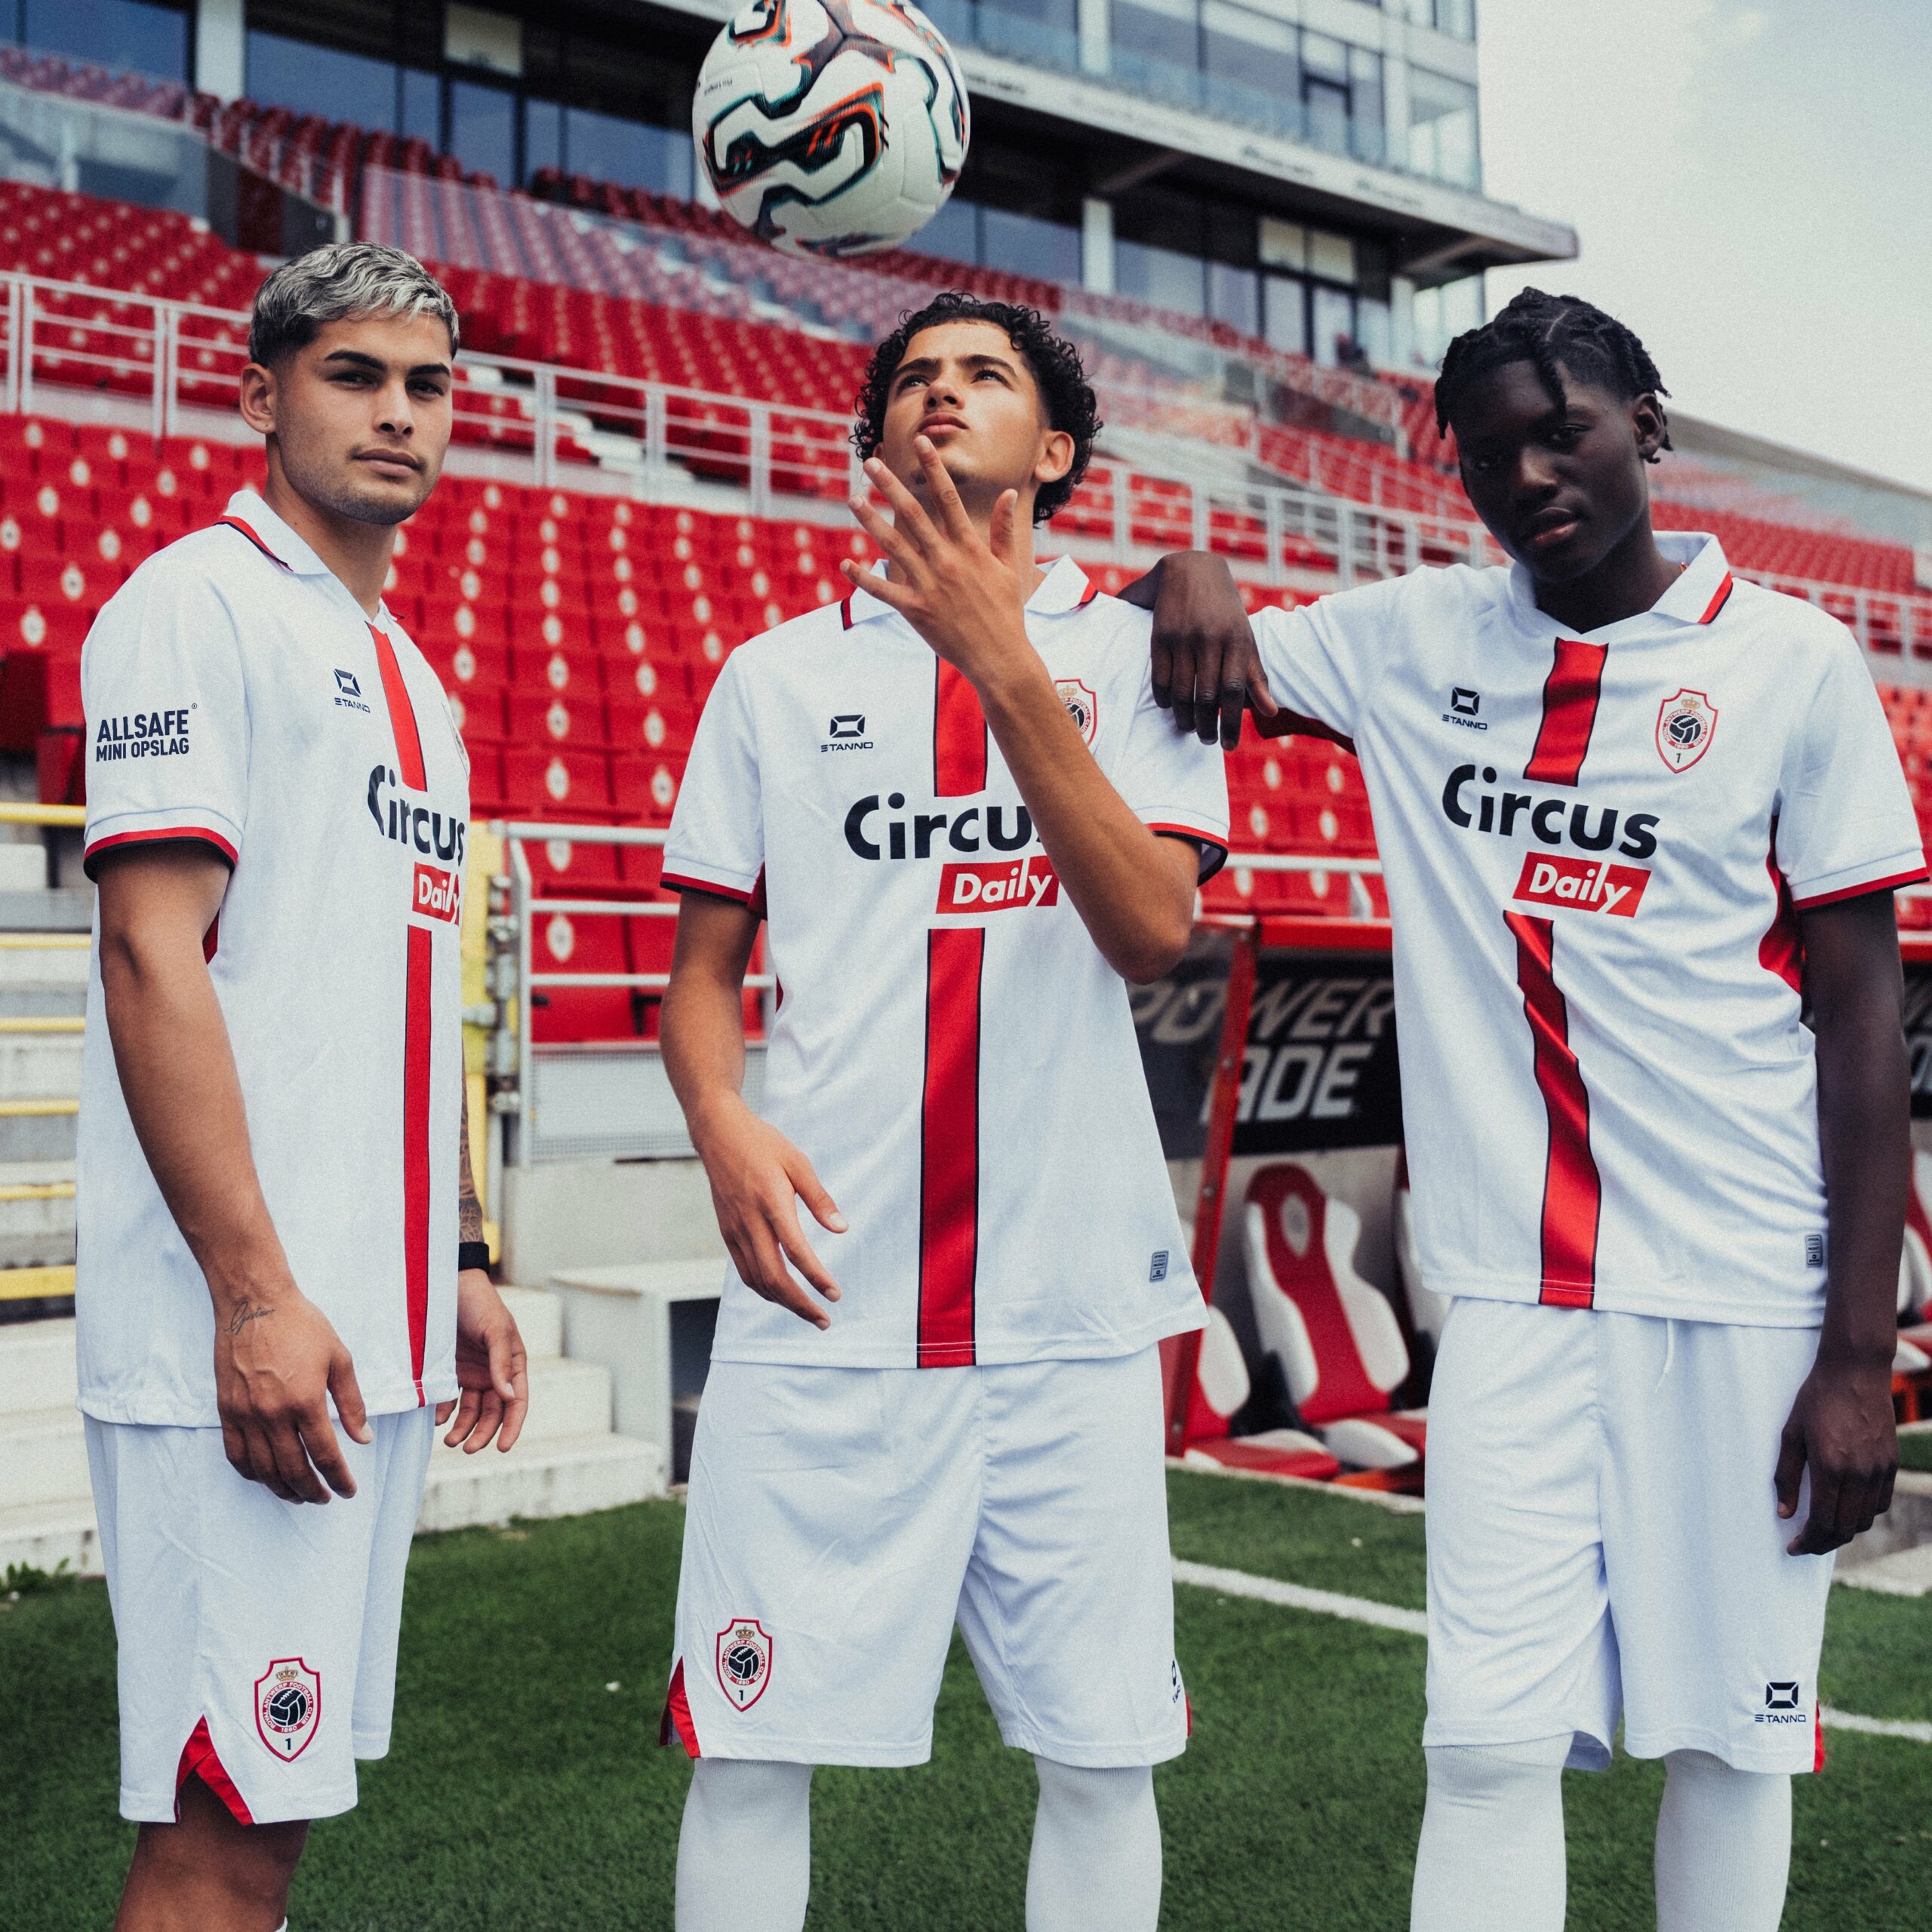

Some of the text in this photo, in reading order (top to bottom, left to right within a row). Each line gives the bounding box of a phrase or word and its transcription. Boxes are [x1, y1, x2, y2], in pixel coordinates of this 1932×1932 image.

[97, 709, 189, 743] ALLSAFE
[96, 737, 189, 762] MINI OPSLAG
[820, 741, 874, 753] STANNO
[1676, 753, 1681, 764] 1
[1441, 764, 1660, 860] Circus
[844, 792, 1041, 860] Circu
[952, 859, 1053, 906] Daily
[1528, 863, 1632, 913] Daily
[263, 1681, 313, 1729] ROYAL ANTWERP FOOTBALL CLUB
[739, 1690, 744, 1701] 1
[281, 1724, 298, 1734] 1880
[1755, 1714, 1807, 1724] STANNO
[285, 1737, 291, 1751] 1
